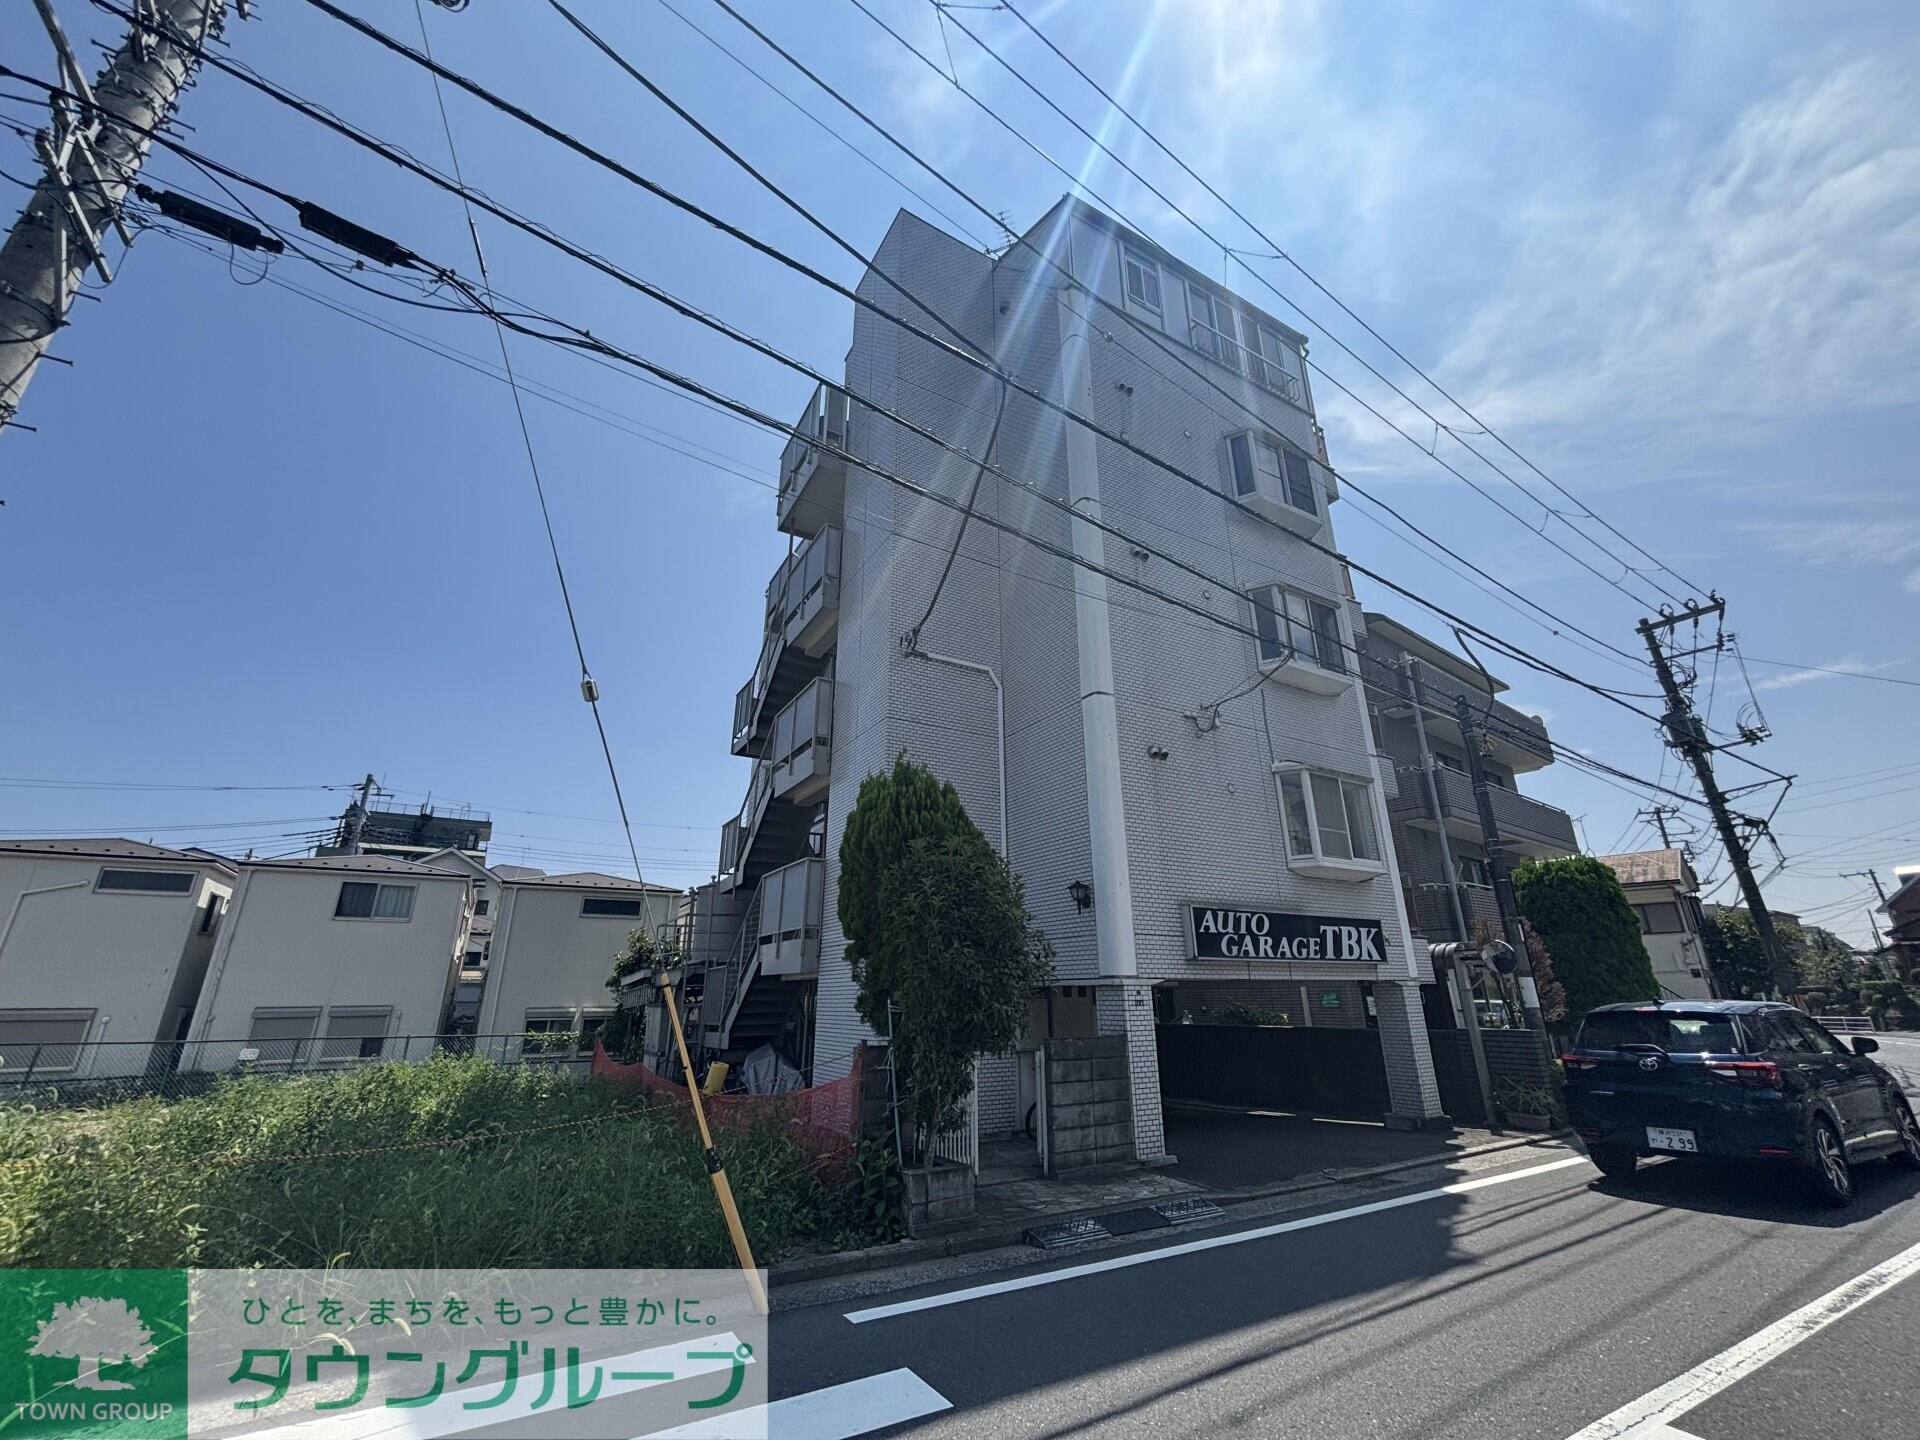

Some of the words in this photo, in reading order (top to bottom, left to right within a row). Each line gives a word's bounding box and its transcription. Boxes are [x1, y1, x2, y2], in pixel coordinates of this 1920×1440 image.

[1200, 909, 1269, 935] AUTO
[1221, 934, 1321, 959] GARAGE
[1320, 924, 1382, 961] TBK
